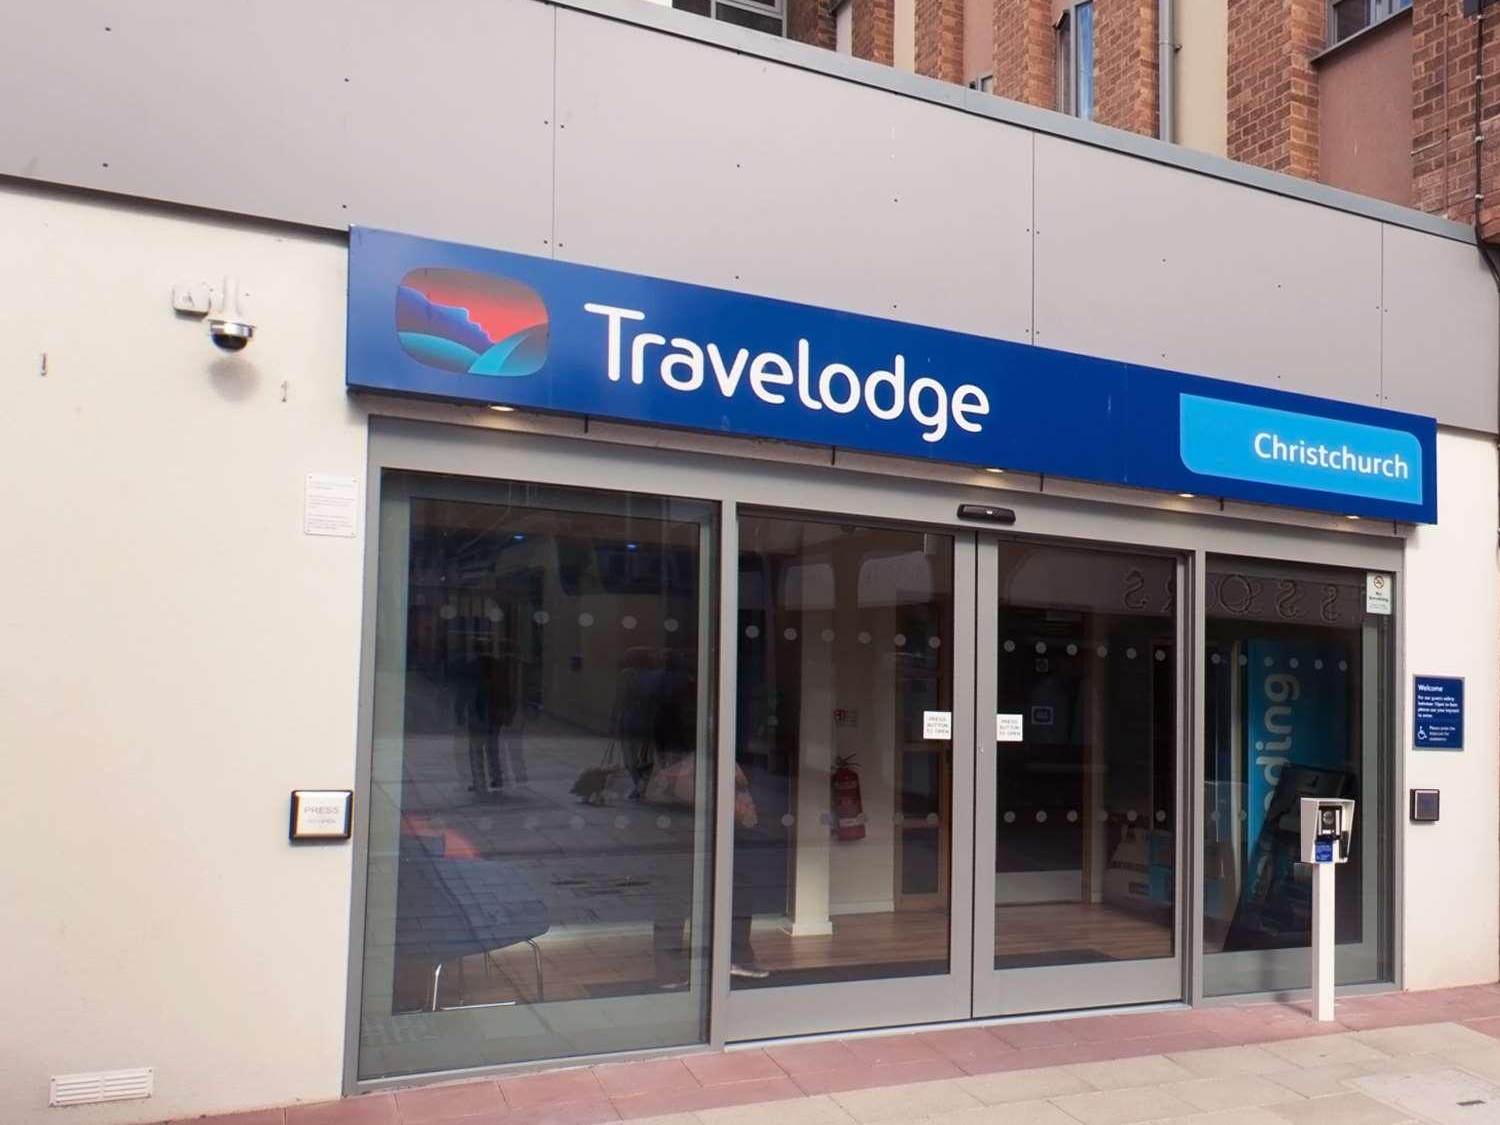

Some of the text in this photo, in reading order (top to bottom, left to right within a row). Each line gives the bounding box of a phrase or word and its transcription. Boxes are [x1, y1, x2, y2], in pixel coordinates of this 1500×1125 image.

[583, 302, 990, 443] Travelodge
[1253, 432, 1410, 481] Christchurch
[1417, 684, 1444, 693] Welcome
[304, 805, 339, 814] PRESS
